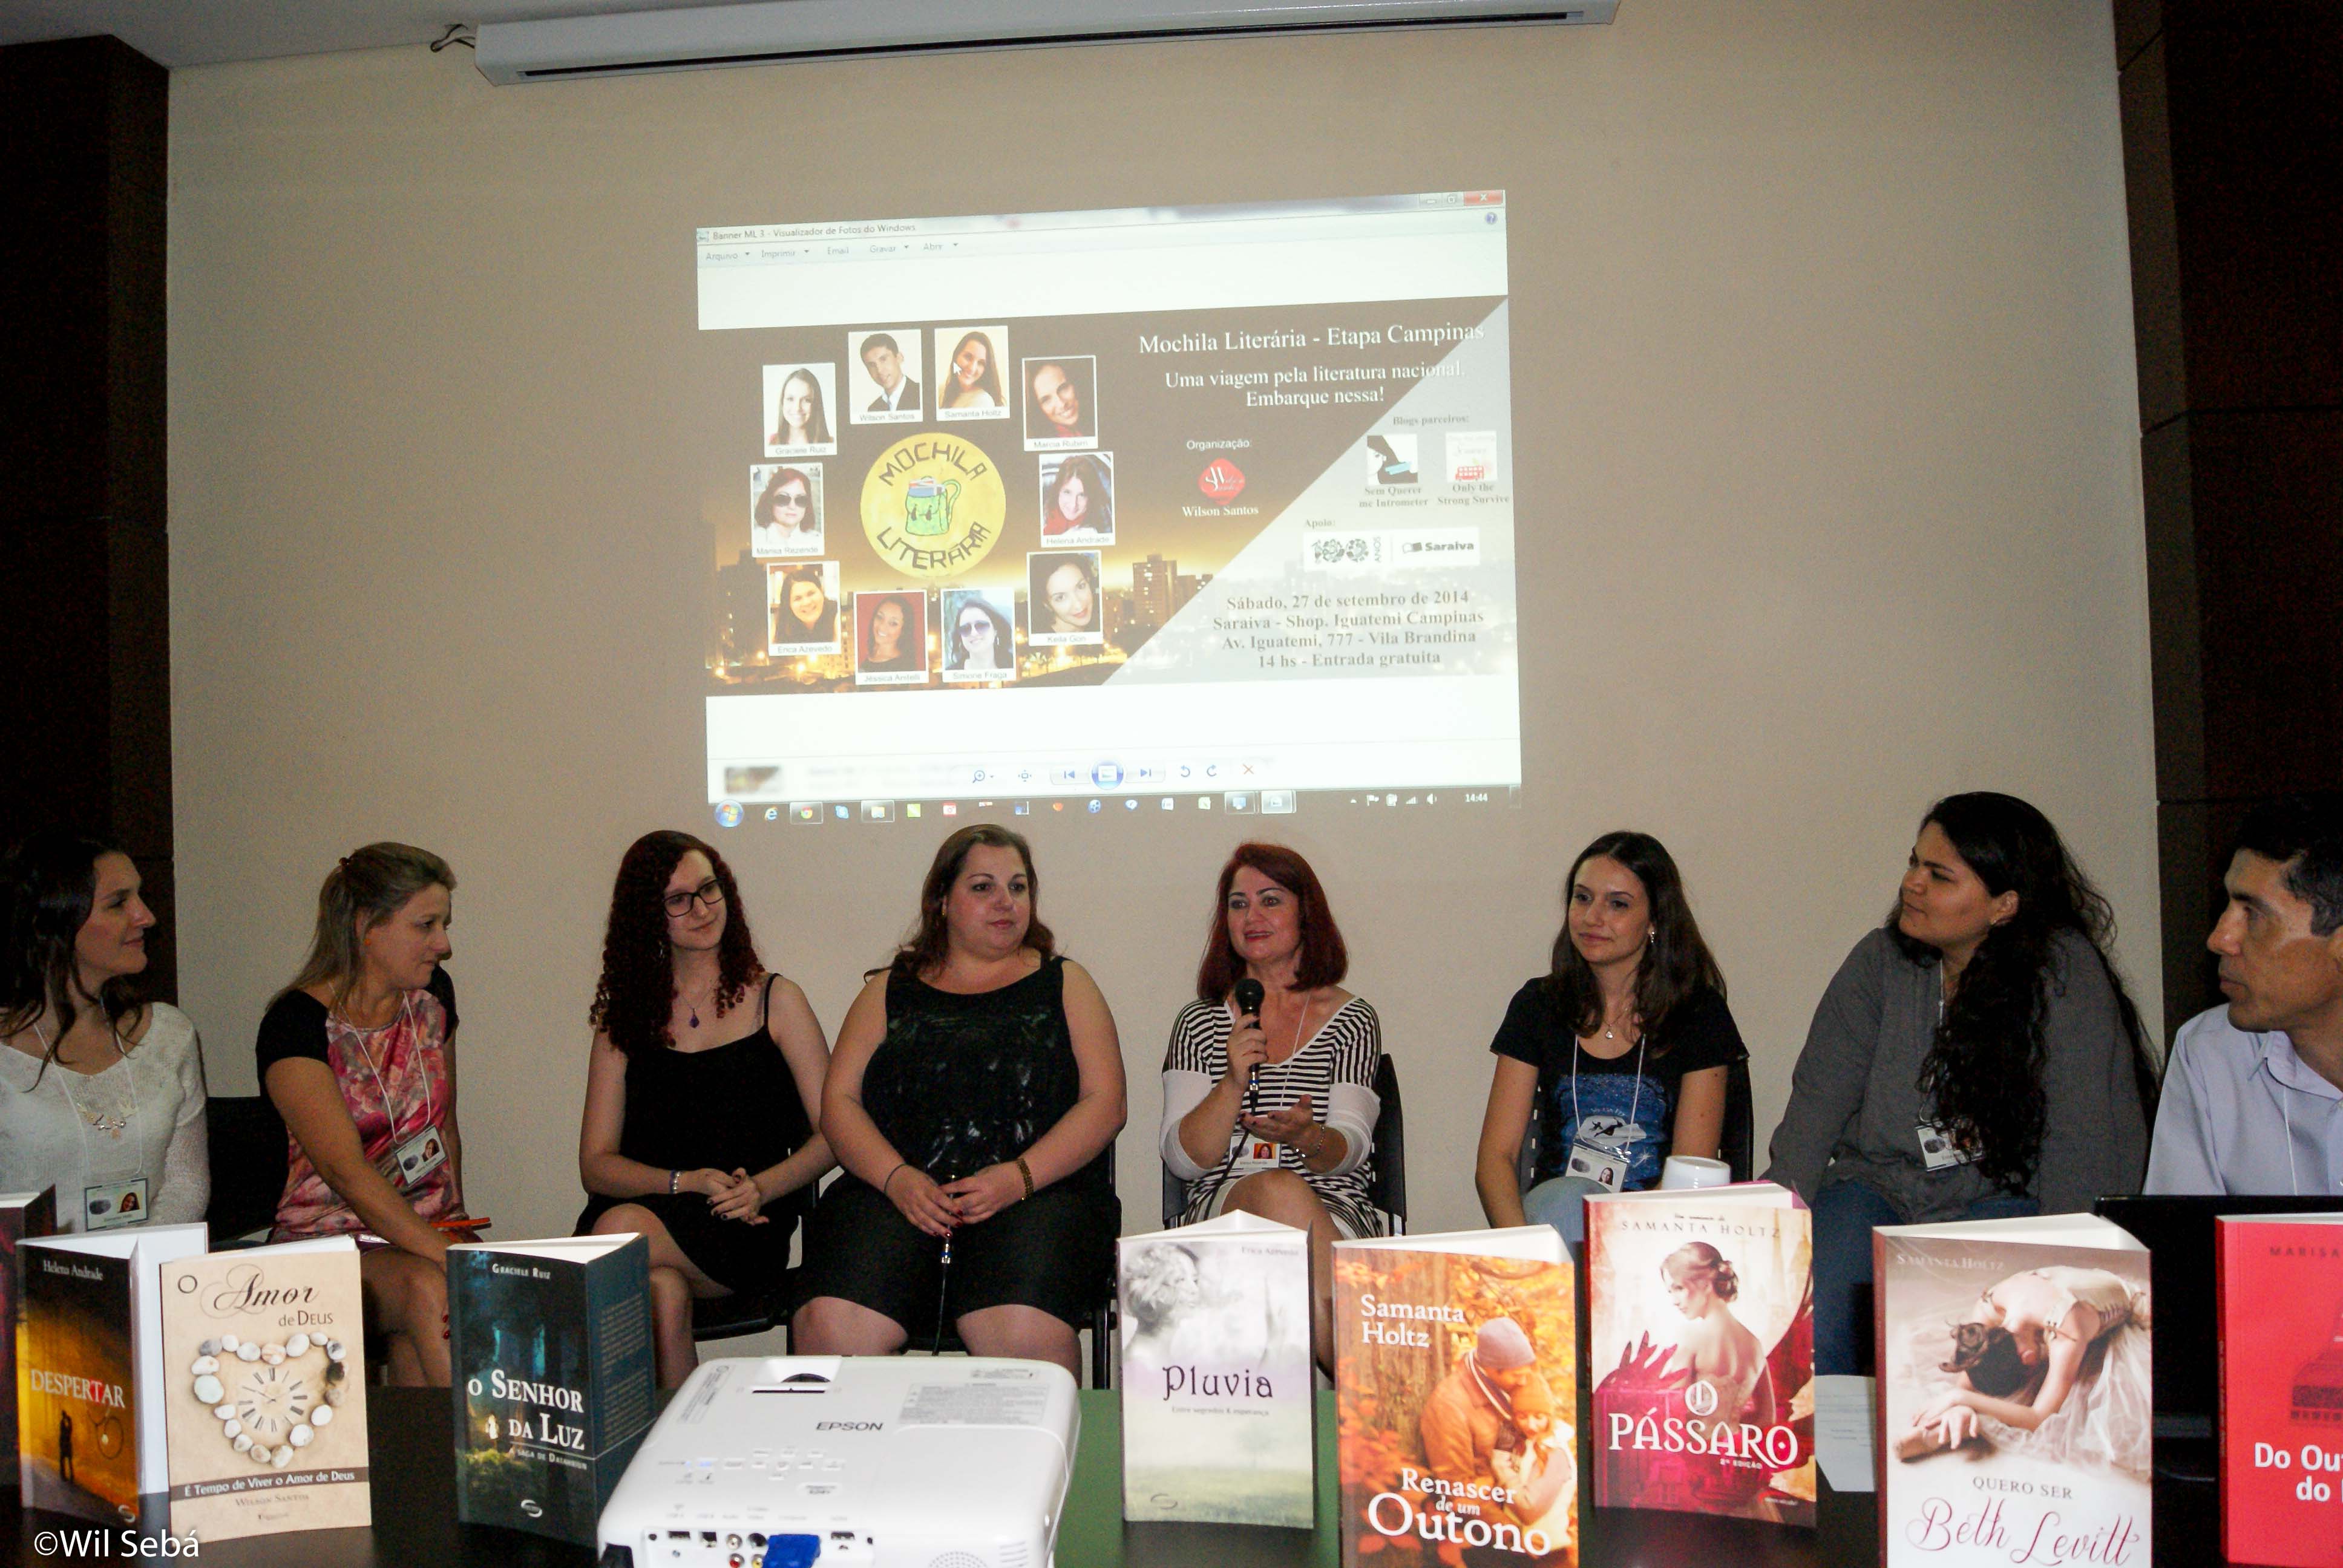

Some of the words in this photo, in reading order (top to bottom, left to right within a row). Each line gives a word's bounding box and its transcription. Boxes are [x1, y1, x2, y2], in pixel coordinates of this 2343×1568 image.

[713, 230, 741, 240] Banner
[773, 227, 823, 238] Visualizador
[877, 223, 916, 232] Windows
[706, 250, 738, 261] Arquivo
[761, 249, 795, 259] Imprimir
[827, 246, 848, 255] Email
[870, 244, 896, 253] Gravar
[923, 243, 943, 252] Abrir
[1139, 333, 1217, 353] Mochila
[1226, 328, 1306, 350] Literária
[1328, 325, 1381, 348] Etapa
[1388, 321, 1484, 344] Campinas
[1165, 371, 1204, 388] Uma
[1209, 369, 1268, 390] viagem
[1274, 365, 1307, 387] pela
[1313, 364, 1386, 383] literatura
[1247, 389, 1328, 408] Embarque
[1334, 386, 1384, 403] nessa!
[1393, 416, 1418, 426] Blogs
[1422, 414, 1469, 426] parceiros:
[879, 442, 988, 486] MOCHILA
[1365, 486, 1385, 495] Sem
[1388, 486, 1421, 495] Querer
[1453, 484, 1476, 492] Only
[1479, 482, 1494, 491] the
[1377, 498, 1428, 507] Intrometer
[1438, 497, 1469, 506] Strong
[1473, 495, 1509, 503] Survive
[1182, 506, 1220, 517] Wilson
[1224, 505, 1259, 515] Santos
[1425, 541, 1474, 551] Saraiva
[1227, 595, 1286, 611] Sábado,
[1293, 595, 1308, 609] 27
[1314, 595, 1331, 608] de
[1337, 592, 1406, 607] setembro
[1411, 592, 1428, 606] de
[1434, 590, 1469, 604] 2014
[1214, 616, 1270, 630] Saraiva
[1286, 614, 1328, 630] Shop.
[1334, 613, 1401, 629] Iguatemi
[1406, 611, 1484, 627] Campinas
[1222, 636, 1244, 650] Av.
[1251, 635, 1322, 651] Iguatemi,
[1328, 633, 1352, 647] 777
[1369, 632, 1398, 645] Vila
[1404, 630, 1476, 645] Brandina
[1258, 655, 1275, 668] 14
[1280, 654, 1297, 667] hs
[1313, 652, 1374, 666] Entrada
[1380, 650, 1441, 668] gratuita
[1465, 793, 1488, 803] 14:44
[1622, 1221, 1708, 1233] SAMANTA
[1721, 1224, 1780, 1238] HOLTZ
[2269, 1246, 2340, 1258] MARISA
[43, 1259, 70, 1278] Helena
[71, 1263, 103, 1281] Andrade
[178, 1275, 198, 1293] O
[200, 1263, 320, 1318] Amor
[1360, 1293, 1466, 1323] Samanta
[278, 1314, 295, 1327] de
[1361, 1322, 1430, 1349] Holtz
[30, 1369, 125, 1409] DESPERTAR
[1162, 1365, 1273, 1401] Pluvia
[816, 1422, 884, 1432] EPSON
[1608, 1406, 1798, 1469] PÁSSARO
[2254, 1442, 2290, 1469] Do
[2301, 1445, 2343, 1472] Ou
[194, 1480, 229, 1497] Tempo
[232, 1478, 245, 1490] de
[247, 1475, 272, 1489] Viver
[275, 1477, 283, 1486] o
[286, 1473, 313, 1485] Amor
[316, 1471, 329, 1483] de
[331, 1469, 355, 1481] Deus
[1401, 1468, 1518, 1504] Renascer
[1973, 1476, 2033, 1496] QUERO
[2040, 1483, 2072, 1499] SER
[2296, 1475, 2331, 1502] do
[1436, 1496, 1453, 1512] de
[1457, 1503, 1481, 1516] um
[1368, 1492, 1552, 1557] Outono
[1905, 1497, 2010, 1552] Beth
[2010, 1510, 2140, 1567] Levitt
